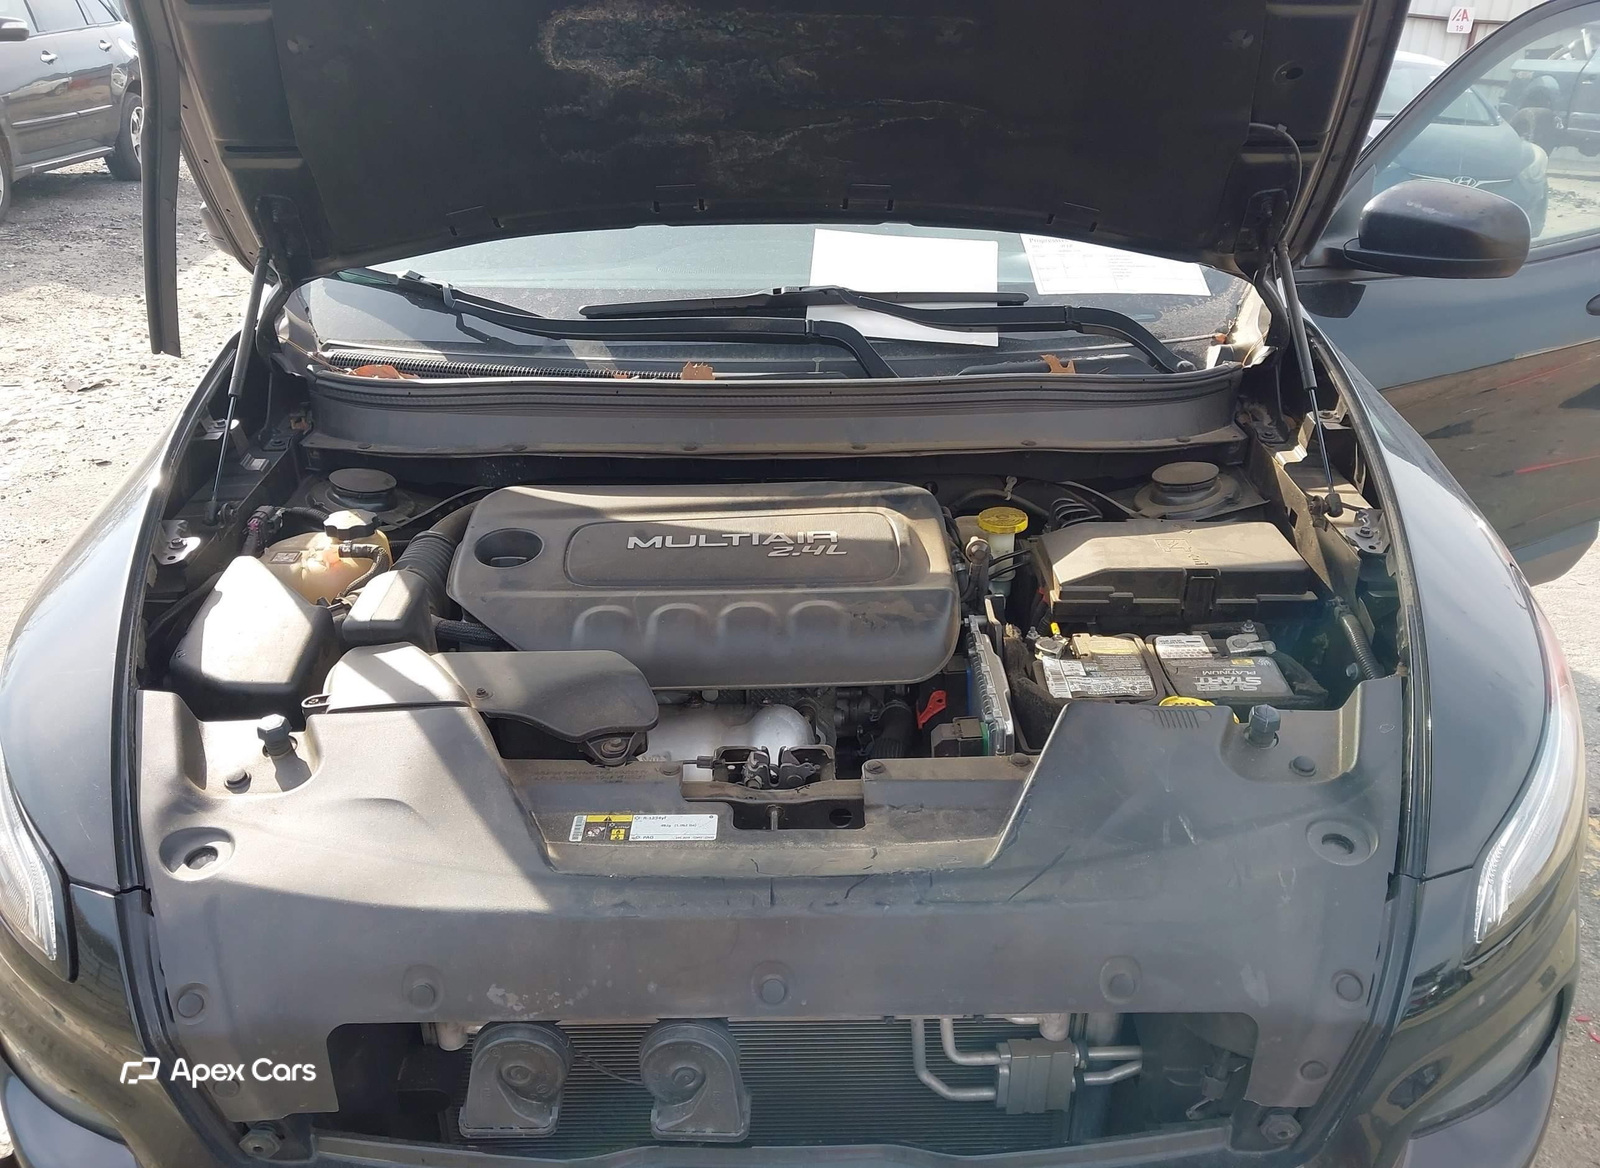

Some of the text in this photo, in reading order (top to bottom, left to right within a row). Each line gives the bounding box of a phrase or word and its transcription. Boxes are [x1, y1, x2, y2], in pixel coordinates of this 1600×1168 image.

[626, 530, 839, 549] MULTIAIR
[767, 544, 848, 557] 2.4L
[1194, 676, 1262, 685] START
[1196, 683, 1258, 692] SUPER
